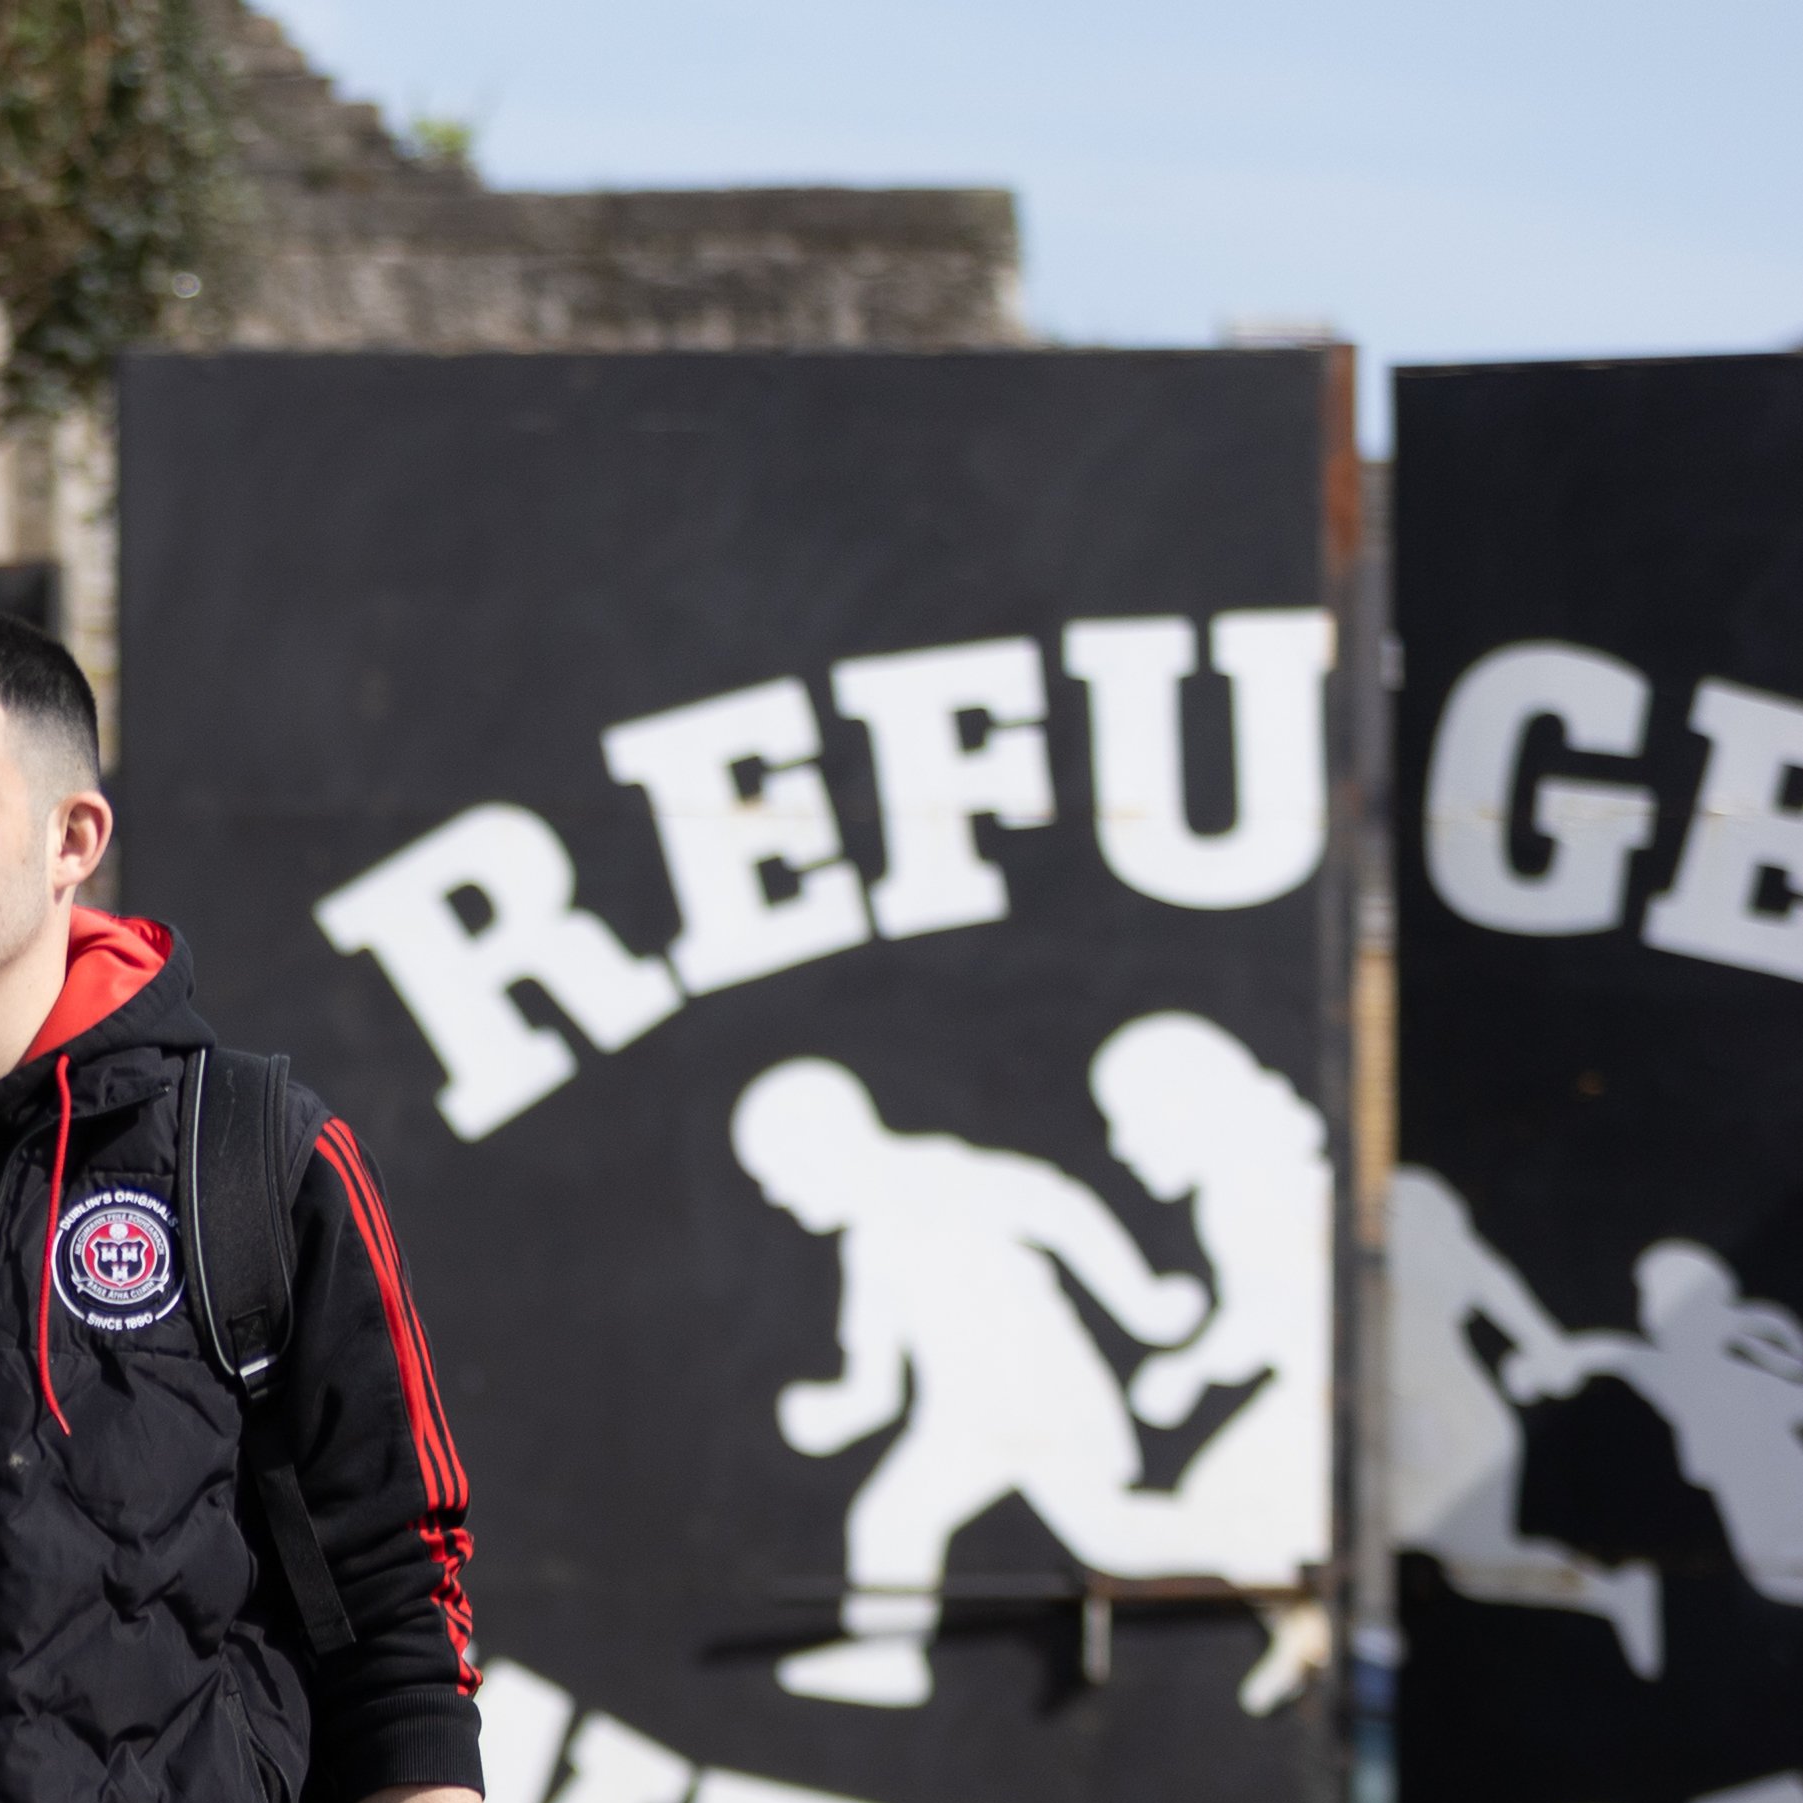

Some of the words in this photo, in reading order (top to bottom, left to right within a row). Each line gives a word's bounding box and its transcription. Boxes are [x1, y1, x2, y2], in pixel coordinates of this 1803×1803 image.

[59, 1191, 112, 1231] DUBLIN'S
[114, 1190, 178, 1227] ORIGINALS
[86, 1312, 122, 1331] SINCE
[125, 1312, 153, 1330] 1890
